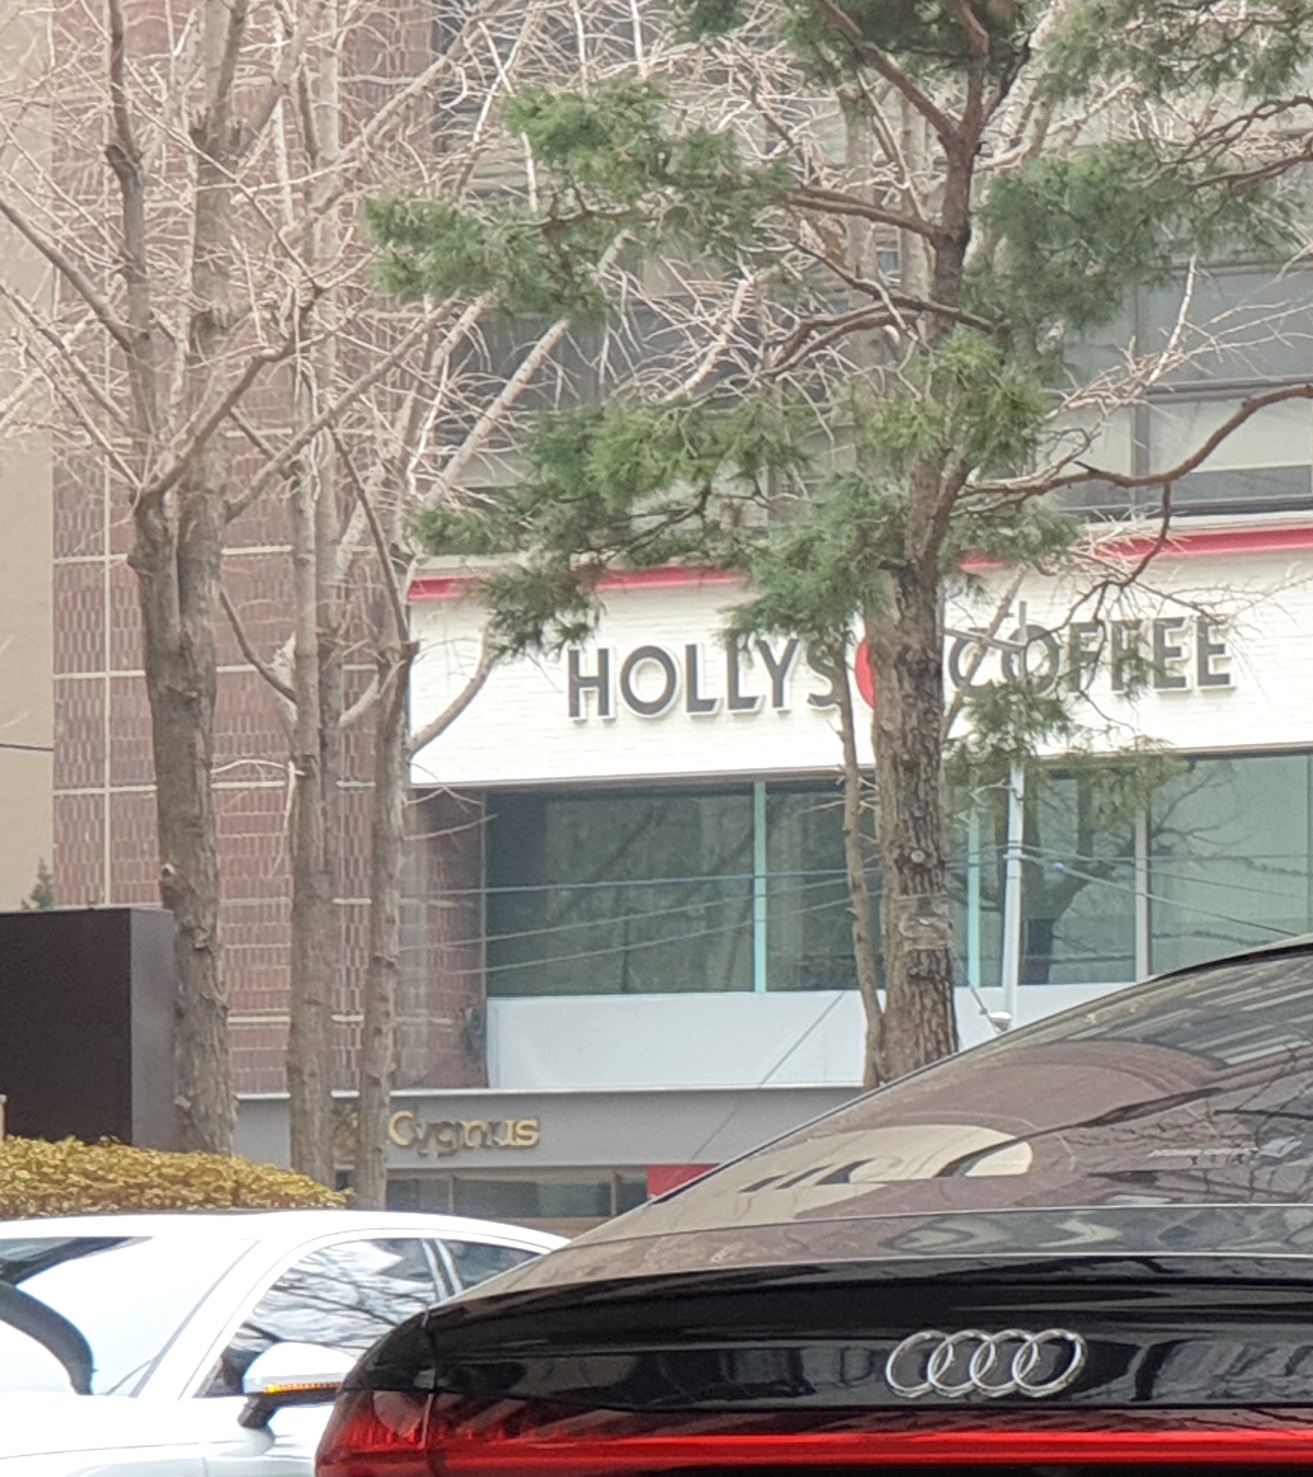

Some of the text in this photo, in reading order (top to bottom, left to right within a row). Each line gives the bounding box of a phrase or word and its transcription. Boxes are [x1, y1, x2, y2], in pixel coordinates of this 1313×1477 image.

[567, 616, 1233, 720] HOLLYS COFFEE
[388, 1110, 540, 1158] Cygnus
